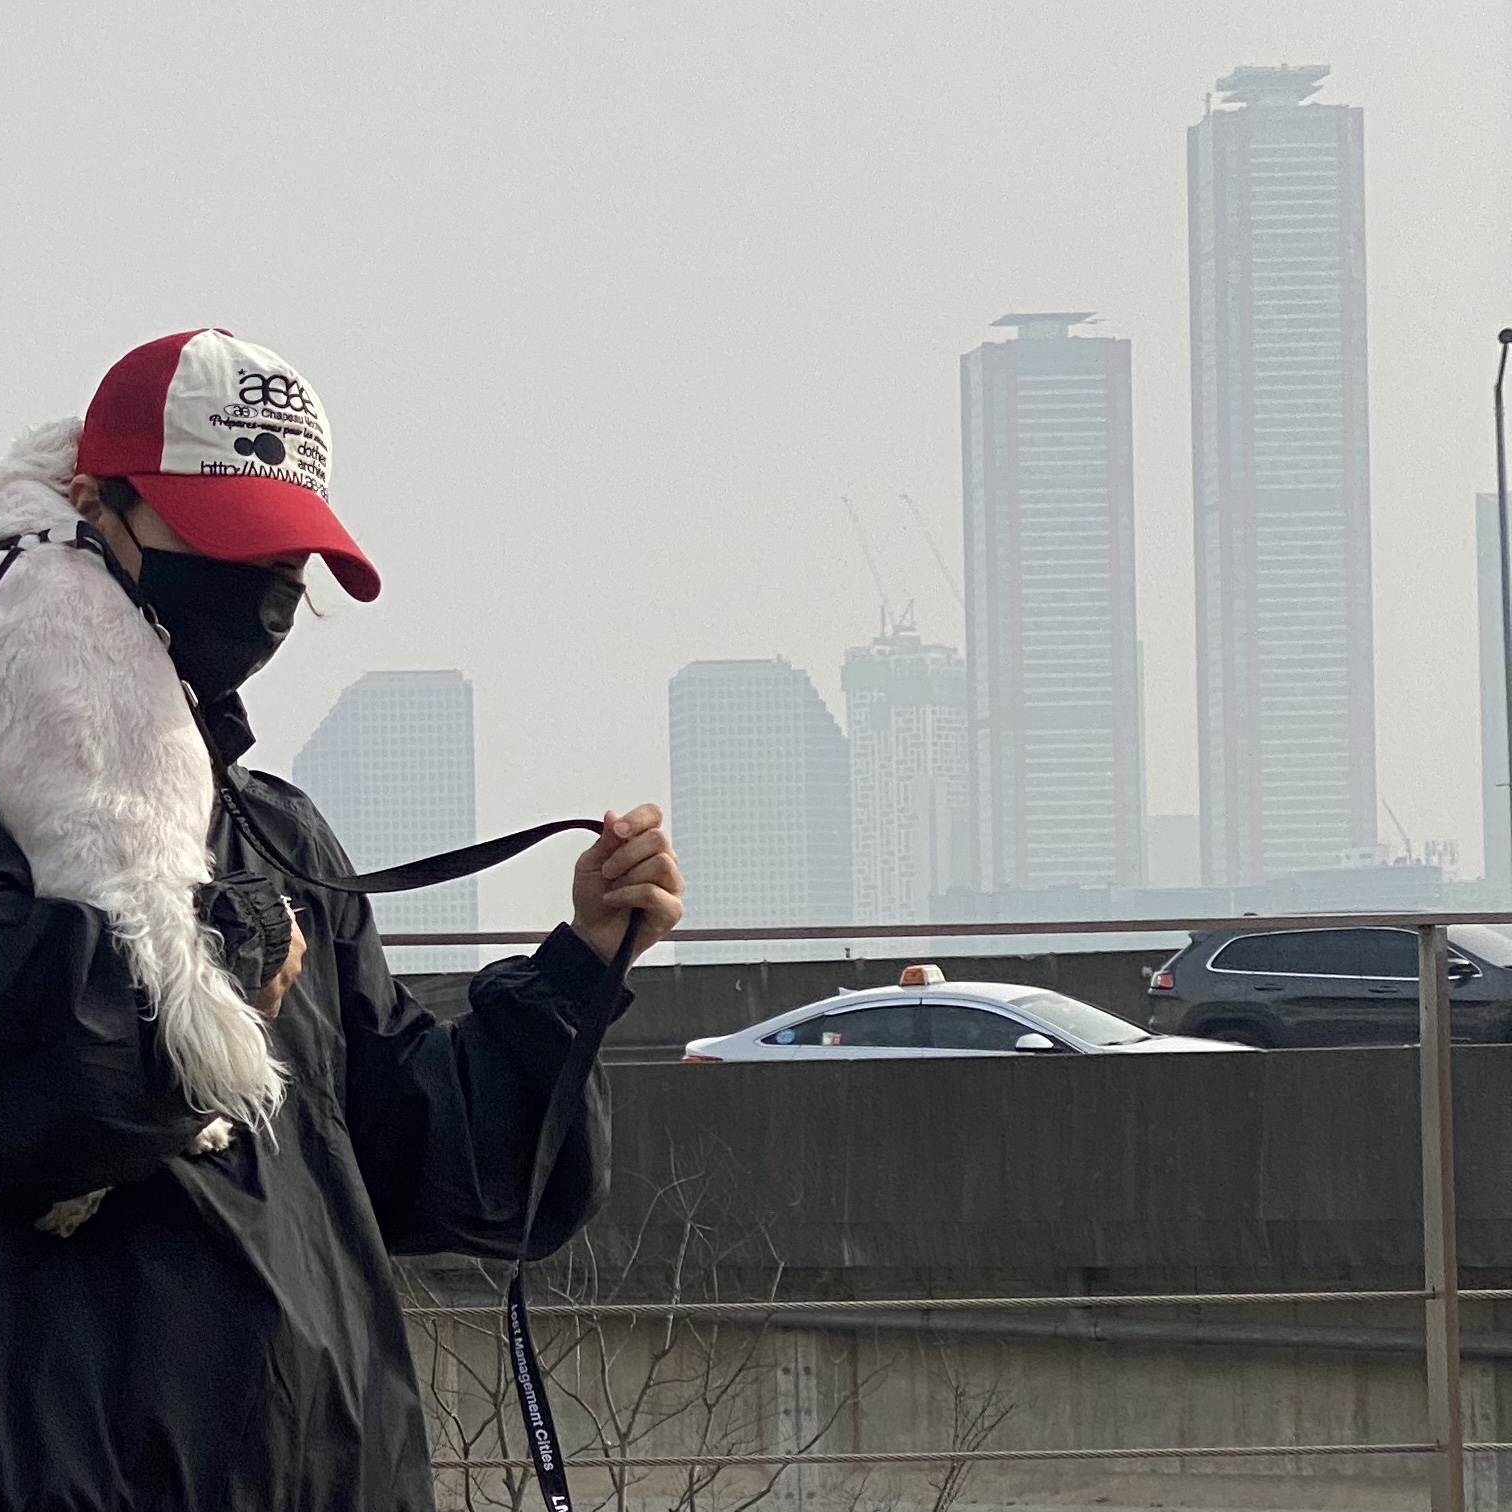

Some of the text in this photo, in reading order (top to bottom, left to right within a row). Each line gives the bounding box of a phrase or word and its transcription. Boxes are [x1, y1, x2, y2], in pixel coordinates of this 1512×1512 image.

[511, 1304, 554, 1471] Lost Management Cities
